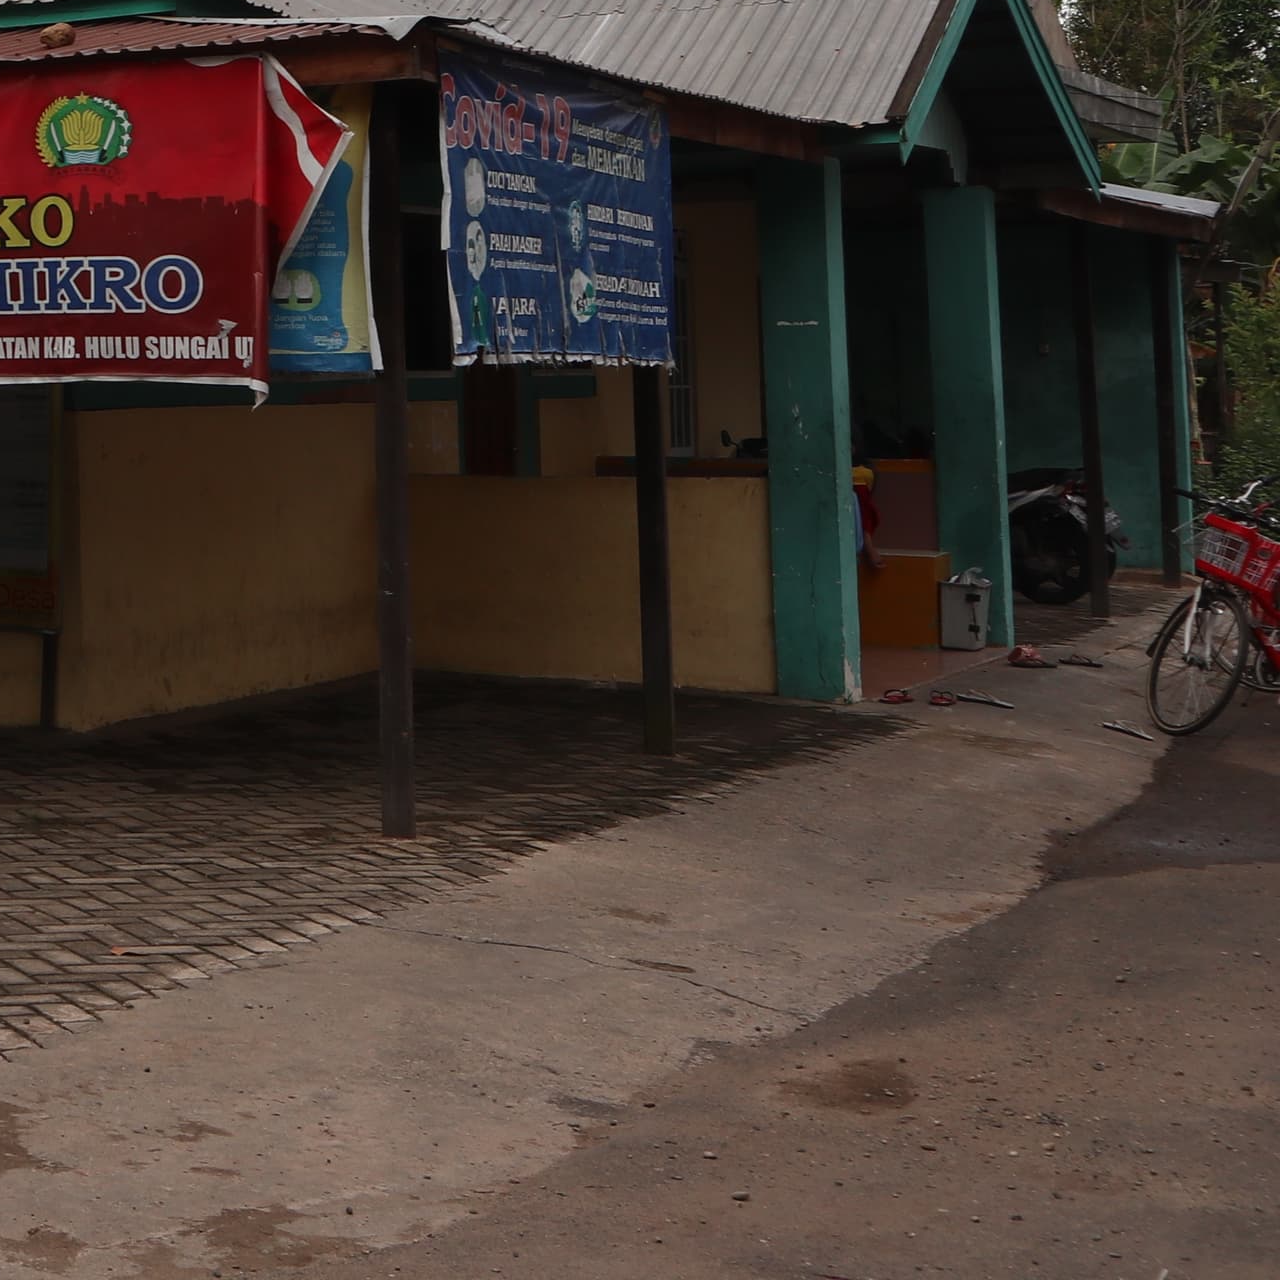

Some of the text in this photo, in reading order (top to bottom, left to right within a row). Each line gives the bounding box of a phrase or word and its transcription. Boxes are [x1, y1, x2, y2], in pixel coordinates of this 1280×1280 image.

[587, 146, 646, 182] MEMATIKAN
[505, 173, 536, 194] TANGAN
[511, 235, 543, 255] MASKER
[44, 336, 80, 359] KAB.
[85, 336, 140, 358] HULU
[145, 335, 229, 358] SUNGAI
